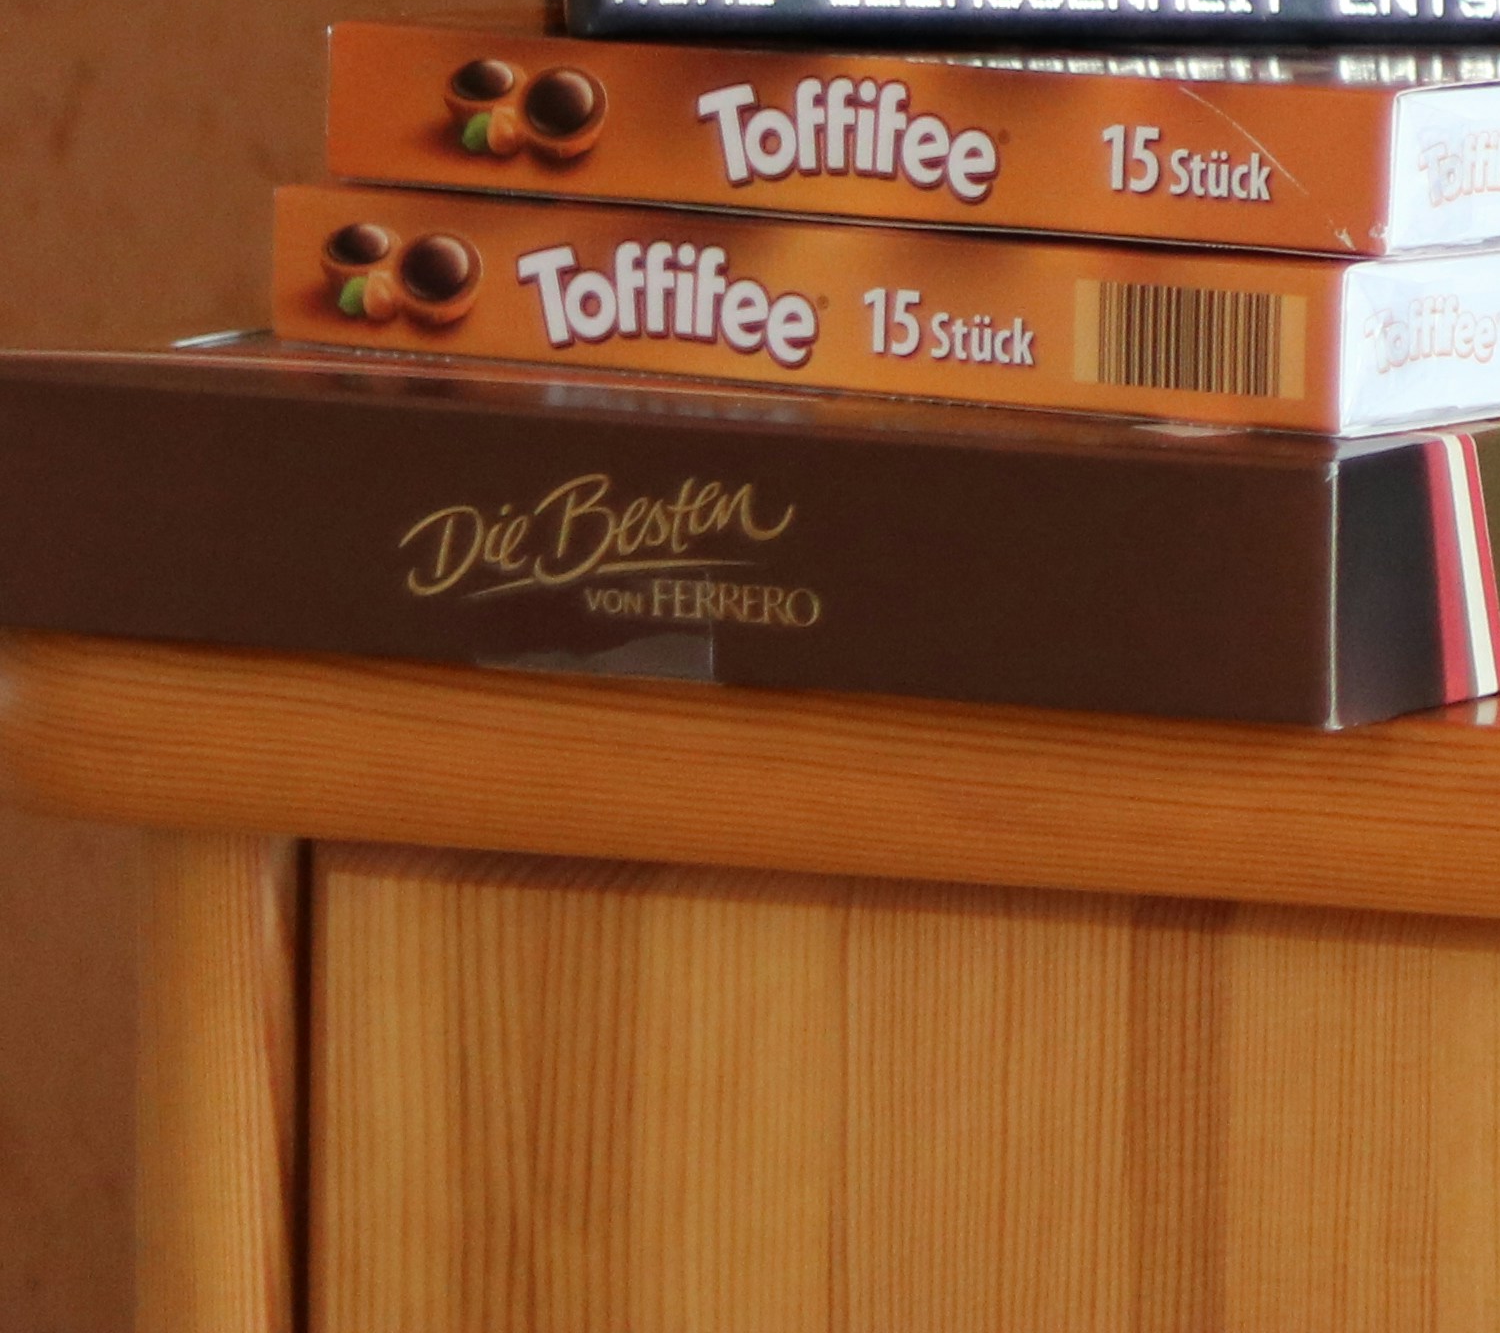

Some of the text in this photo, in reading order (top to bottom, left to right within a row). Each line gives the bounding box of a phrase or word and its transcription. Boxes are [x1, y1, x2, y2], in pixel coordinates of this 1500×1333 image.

[698, 77, 998, 203] Toffifee
[1102, 125, 1272, 203] 15 Stück
[517, 239, 819, 367] Toffifee
[863, 286, 1035, 367] 15 Stück
[400, 473, 796, 597] Die Besten
[651, 578, 821, 628] FERRERO
